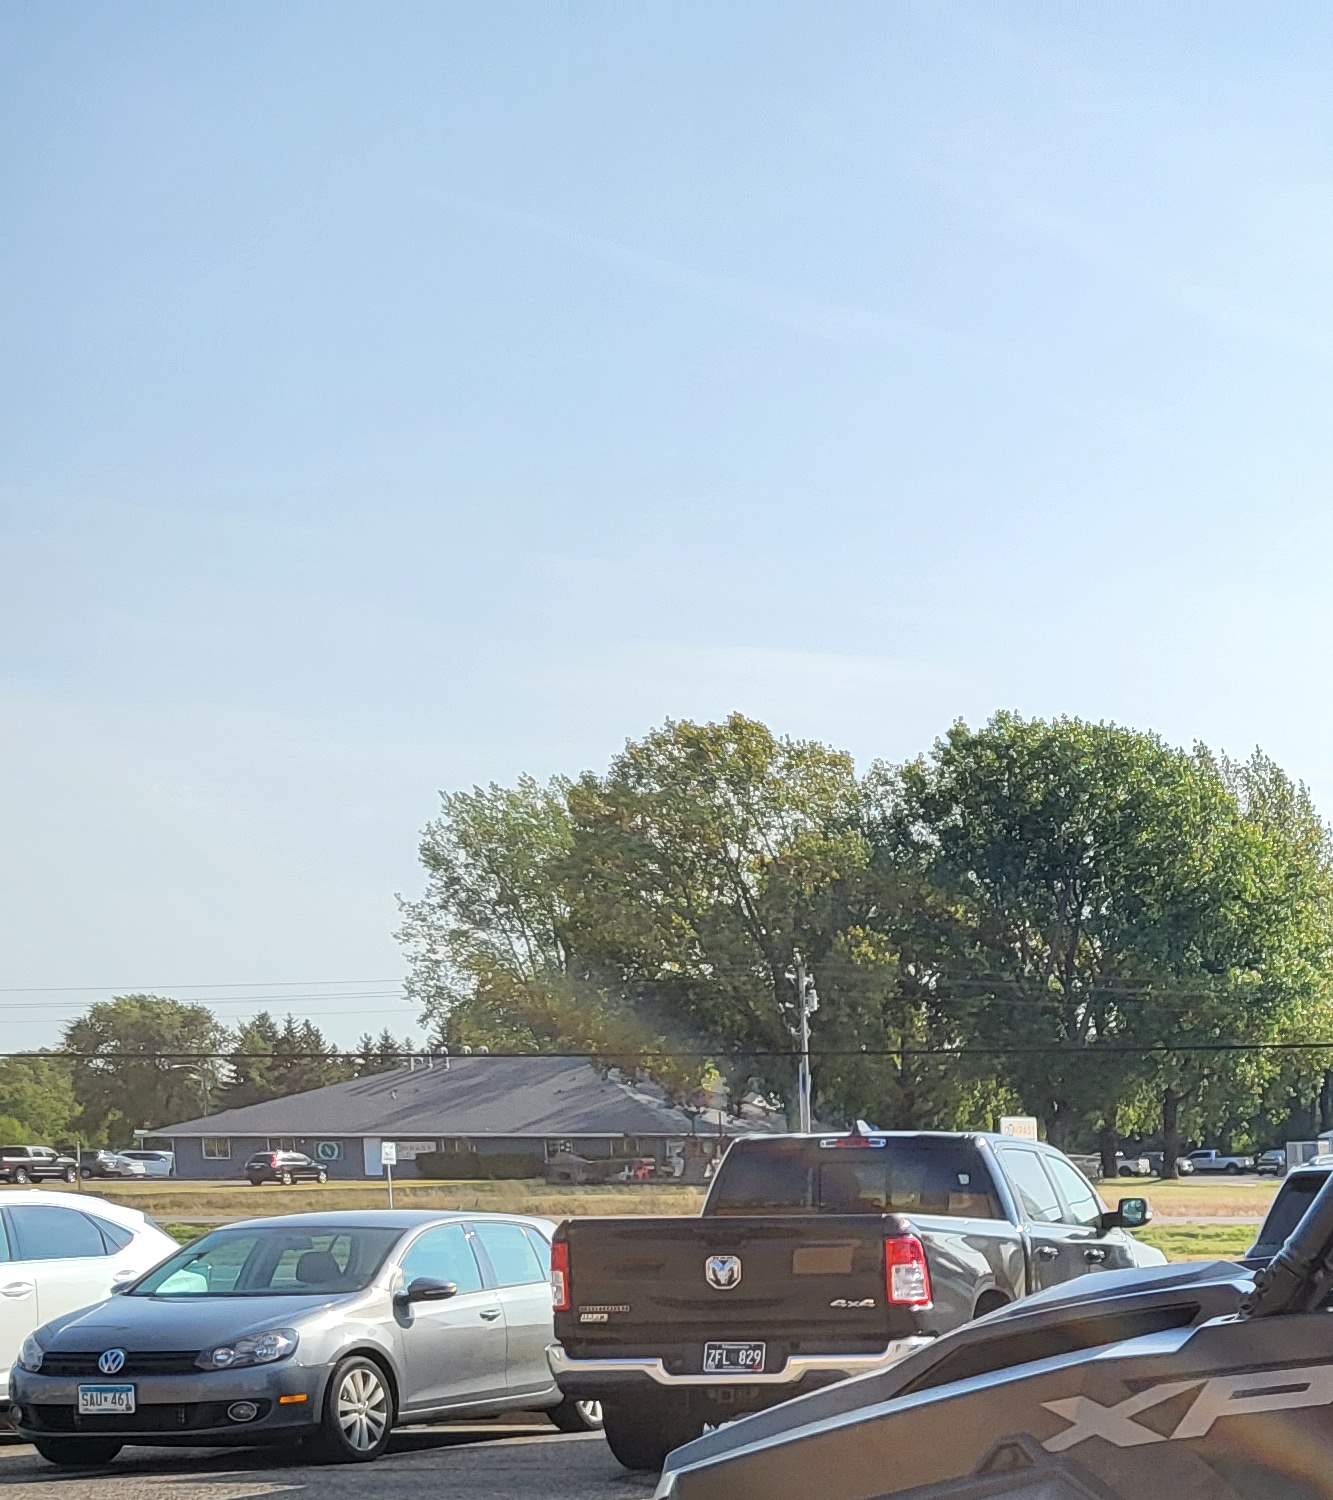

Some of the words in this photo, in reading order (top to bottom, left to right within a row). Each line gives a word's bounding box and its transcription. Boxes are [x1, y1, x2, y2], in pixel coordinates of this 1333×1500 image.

[707, 1349, 731, 1365] ZFL
[738, 1349, 762, 1365] 829
[81, 1392, 103, 1407] SAU
[110, 1392, 131, 1407] 461
